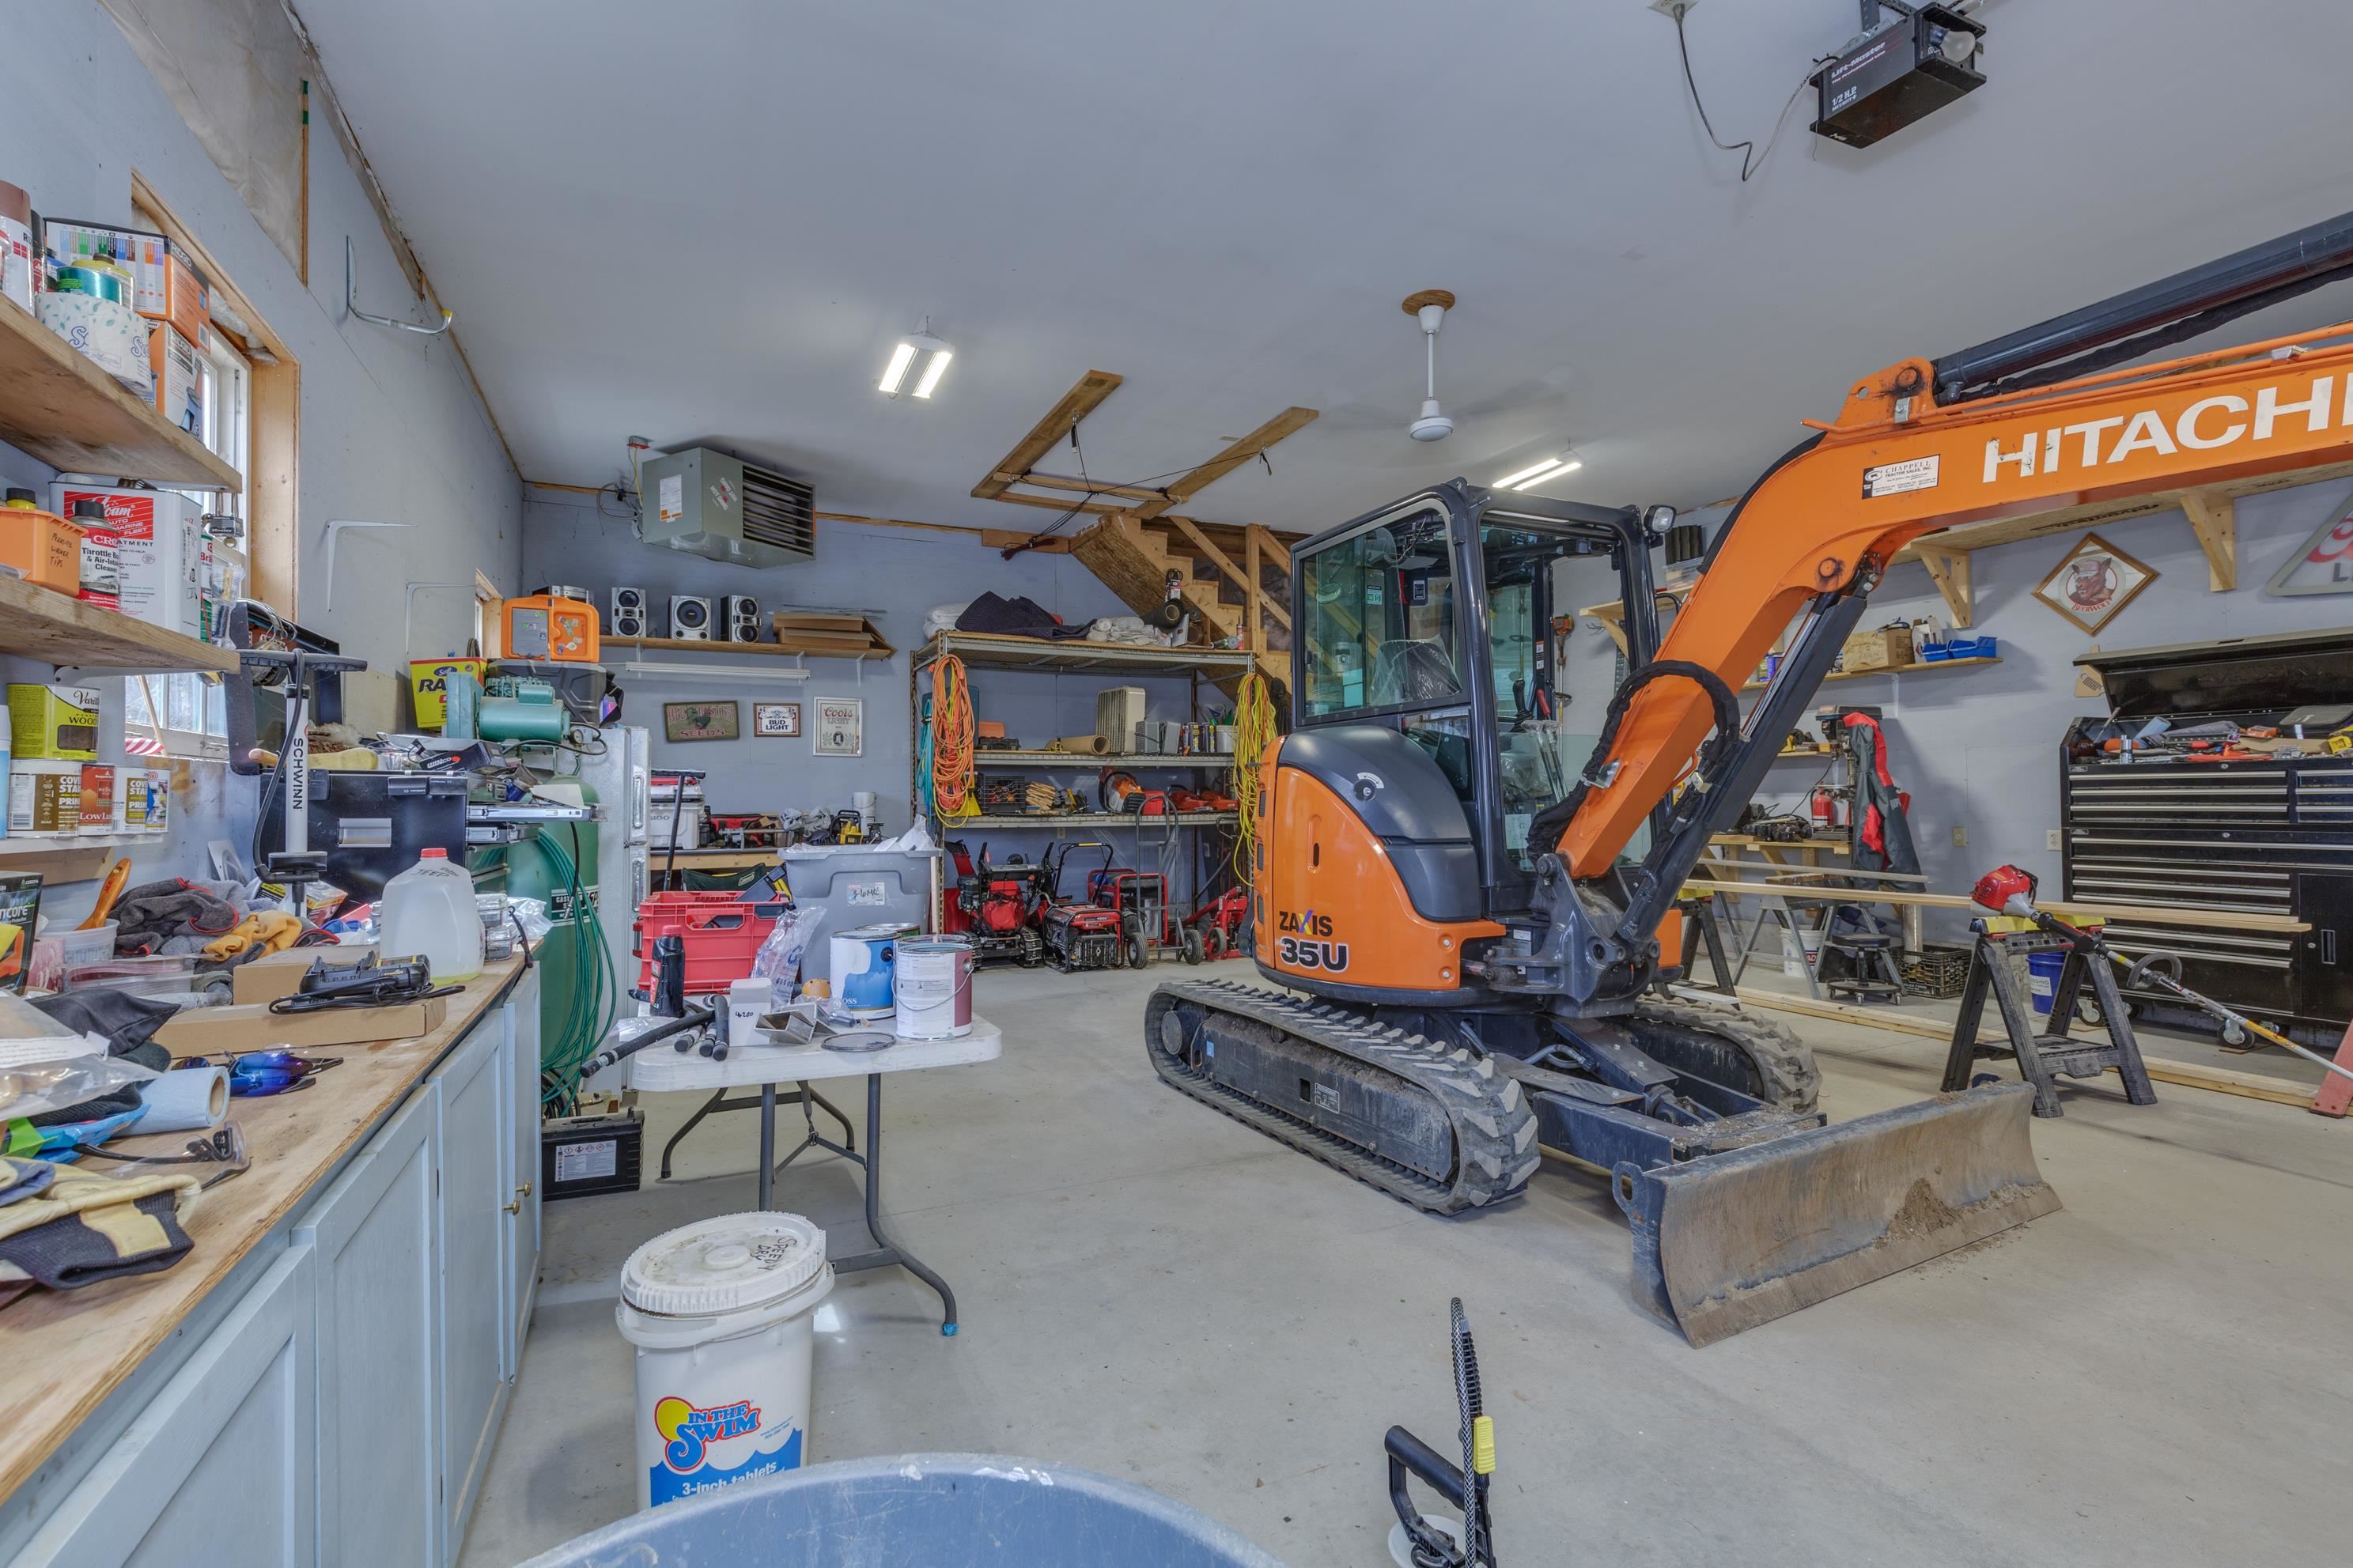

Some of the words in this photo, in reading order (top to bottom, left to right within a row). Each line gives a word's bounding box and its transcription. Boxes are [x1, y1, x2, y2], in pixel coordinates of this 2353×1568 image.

[81, 547, 112, 557] Throttle
[95, 564, 118, 573] Cleaner
[823, 706, 853, 718] Coors
[293, 738, 304, 810] SCHWINN
[1279, 910, 1333, 936] ZAXIS
[1280, 937, 1349, 973] 35U
[755, 1245, 771, 1260] DRY
[758, 1236, 797, 1271] SPEEDY
[688, 1411, 708, 1424] IN
[710, 1404, 748, 1420] THE
[668, 1411, 758, 1469] SWIM
[683, 1478, 728, 1495] 3-inch
[731, 1461, 777, 1484] tablets
